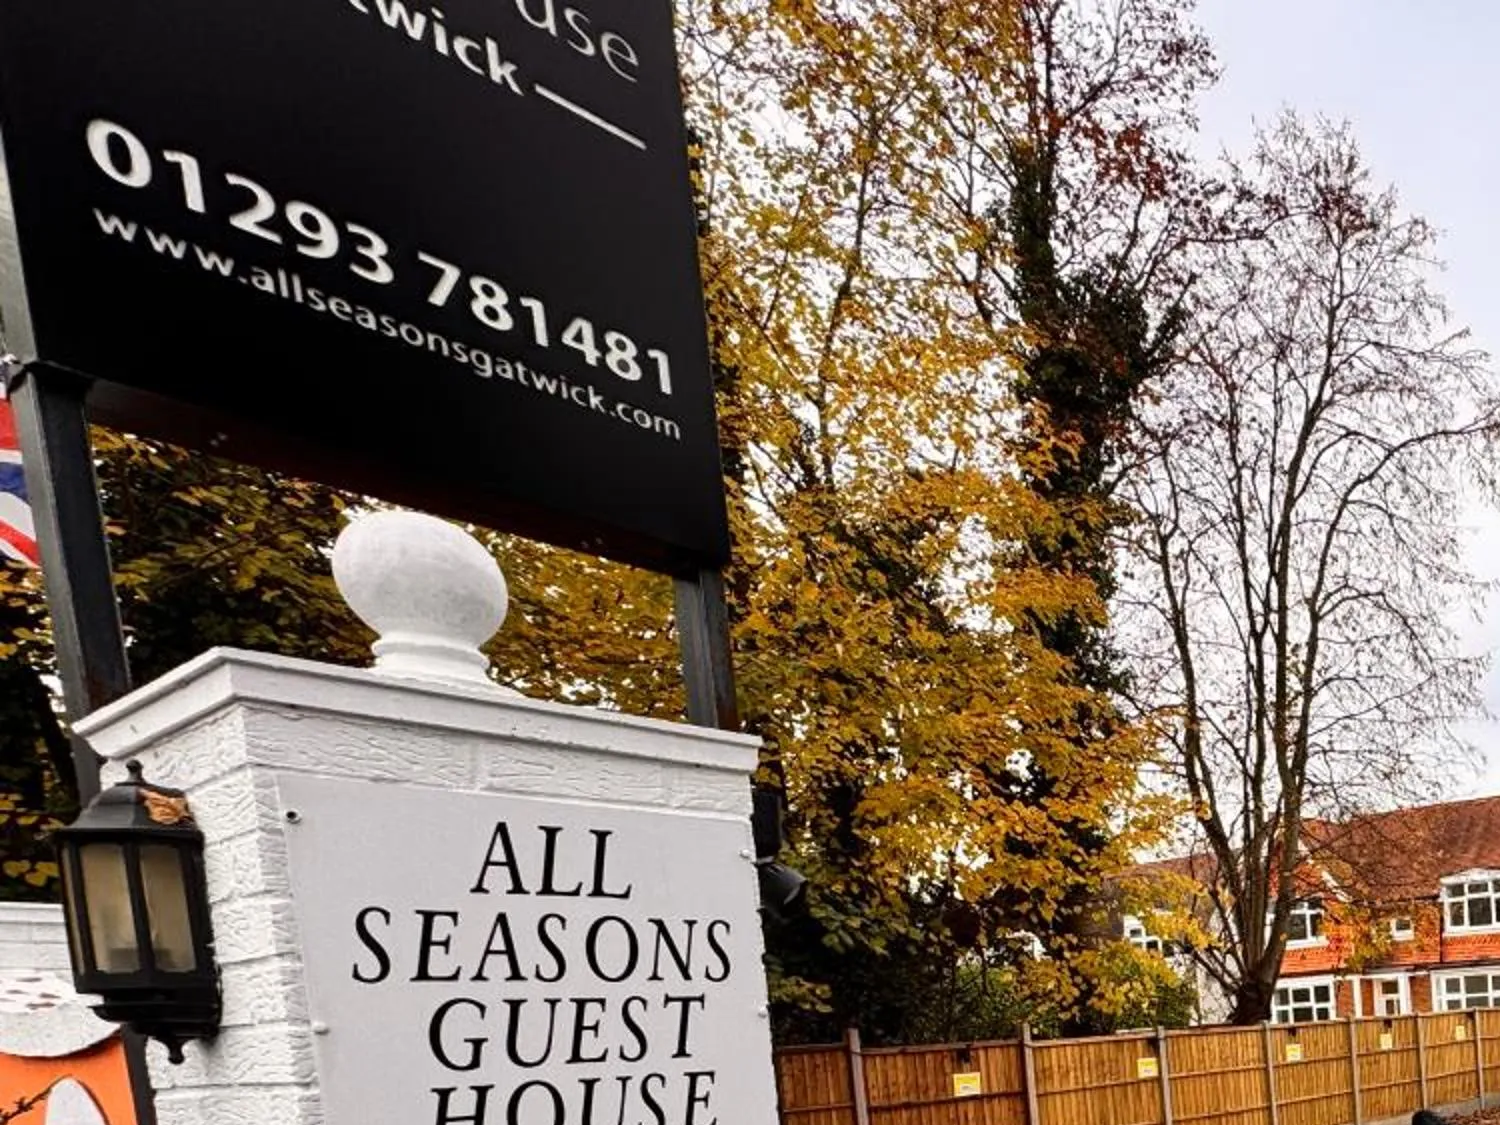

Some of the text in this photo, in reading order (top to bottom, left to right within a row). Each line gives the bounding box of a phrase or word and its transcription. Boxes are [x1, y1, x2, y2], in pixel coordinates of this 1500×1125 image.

[348, 0, 524, 96] wick
[86, 119, 674, 396] 01293 781481
[94, 209, 681, 441] www.allseasonsgatwick.com
[469, 820, 633, 900] ALL
[352, 906, 732, 984] SEASONS
[428, 993, 706, 1072] GUEST
